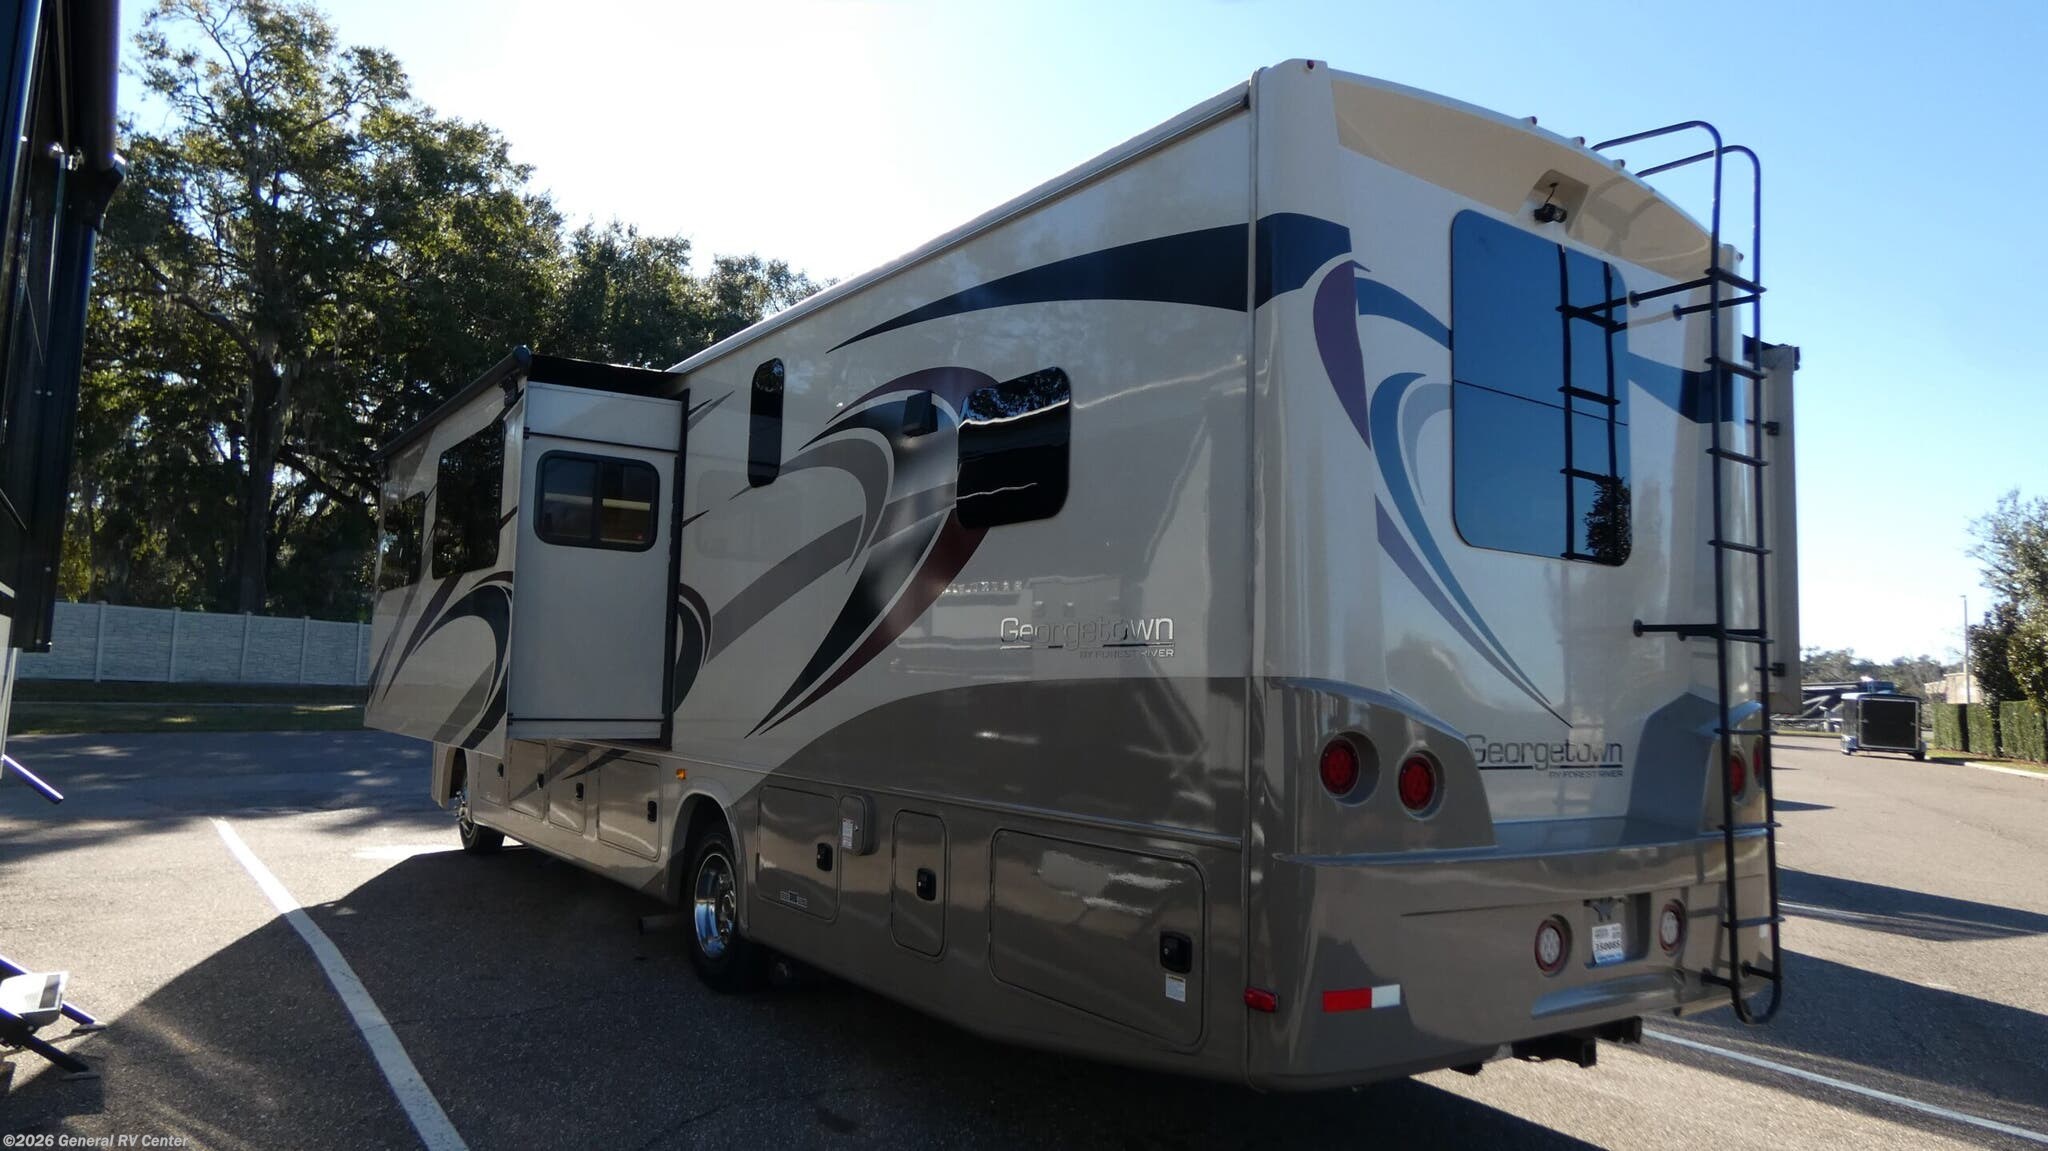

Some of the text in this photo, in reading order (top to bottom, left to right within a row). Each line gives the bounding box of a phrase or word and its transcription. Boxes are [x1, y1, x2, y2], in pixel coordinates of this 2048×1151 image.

[1000, 617, 1175, 649] Georgetown
[1140, 649, 1175, 657] RIVER
[1466, 734, 1623, 770] Georgetown
[1563, 770, 1597, 778] FOREST
[1600, 769, 1624, 777] RIVER
